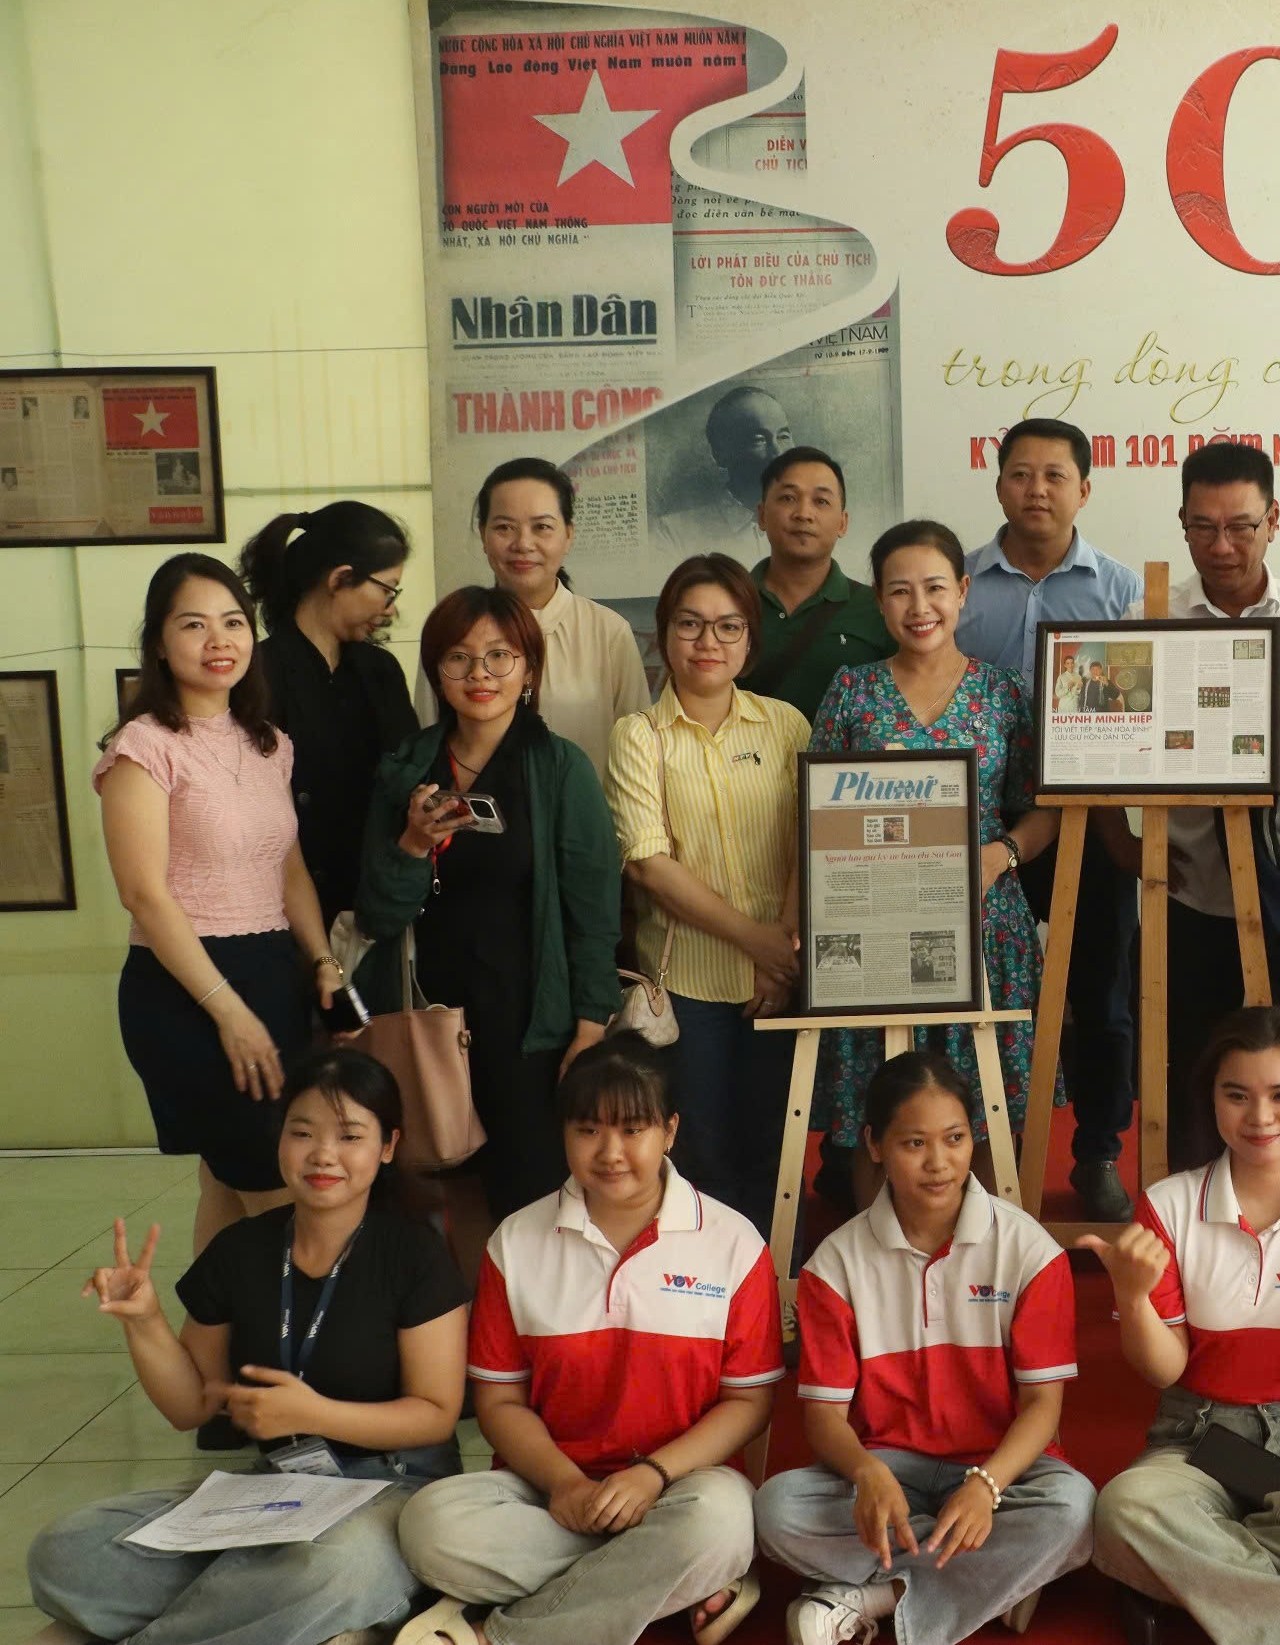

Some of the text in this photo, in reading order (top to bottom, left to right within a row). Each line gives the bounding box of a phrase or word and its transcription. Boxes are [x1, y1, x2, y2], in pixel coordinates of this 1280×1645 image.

[656, 33, 678, 46] NAM
[488, 60, 513, 75] Lao
[608, 55, 642, 70] Nam
[525, 218, 548, 230] NAM
[716, 253, 748, 270] PHÁT
[787, 252, 810, 267] CỦA
[815, 251, 839, 267] CHỦ
[844, 252, 872, 269] TỊCH
[730, 273, 753, 289] TÔN
[451, 295, 563, 340] Nhân
[572, 293, 658, 337] Dân
[941, 345, 1093, 421] trong
[1113, 330, 1241, 424] dòng
[453, 386, 566, 435] THÀNH
[1125, 434, 1178, 468] 101
[1095, 714, 1126, 724] MINH
[663, 1273, 698, 1289] VOV
[695, 1281, 726, 1294] College
